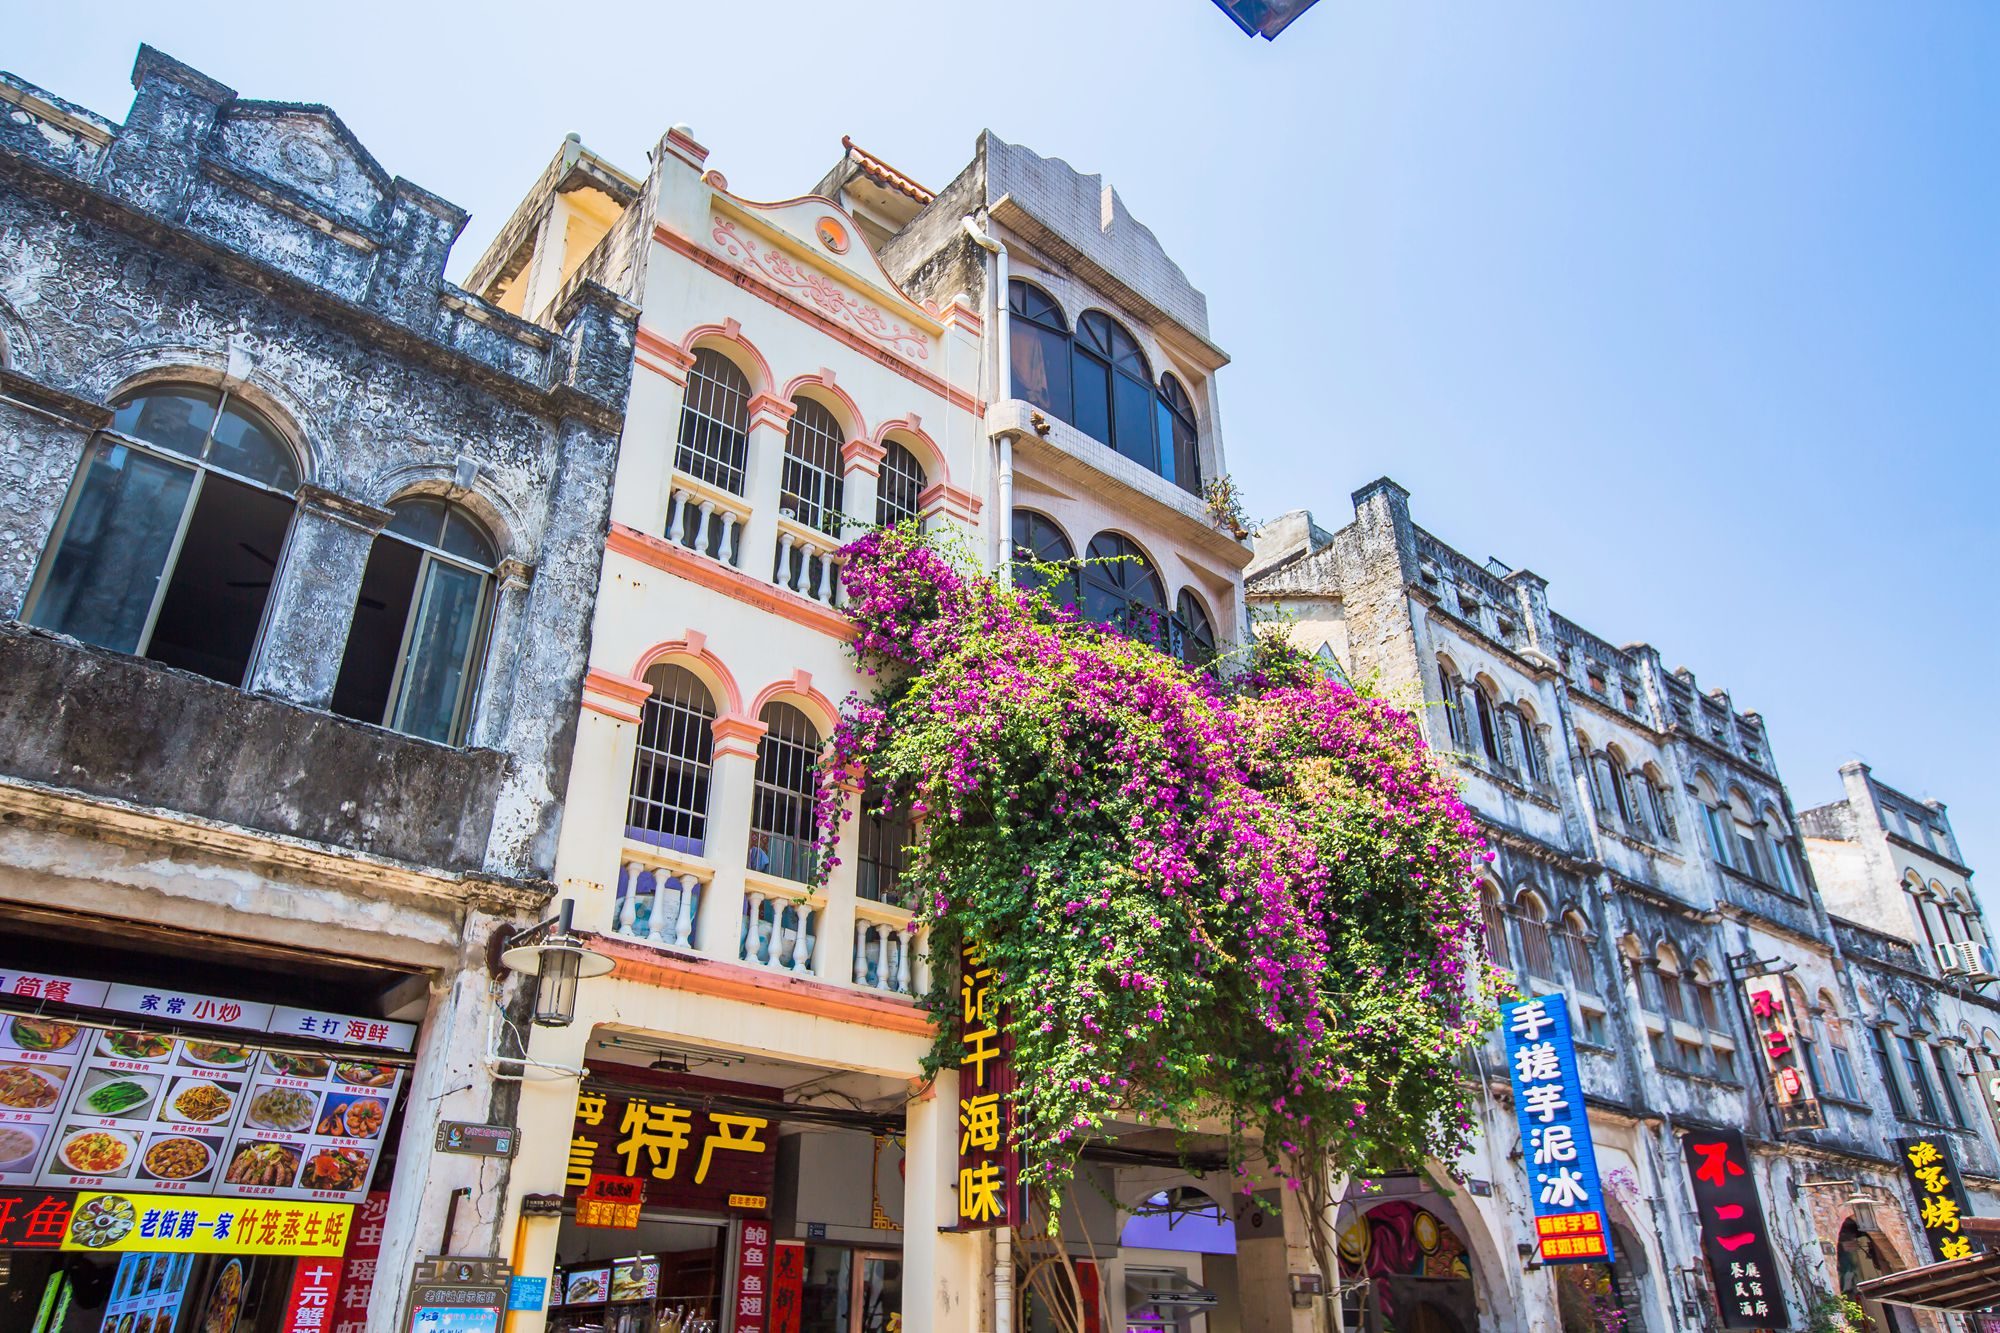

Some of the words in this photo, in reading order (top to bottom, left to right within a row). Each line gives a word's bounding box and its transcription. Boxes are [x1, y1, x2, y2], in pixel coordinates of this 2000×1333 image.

[959, 936, 1001, 1221] 记干海味
[1510, 1001, 1588, 1207] 手搓芋泥冰
[616, 1097, 768, 1185] 特产
[1693, 1142, 1755, 1251] 不二
[292, 1265, 333, 1333] 十元蟹
[1734, 1282, 1763, 1297] 民宿
